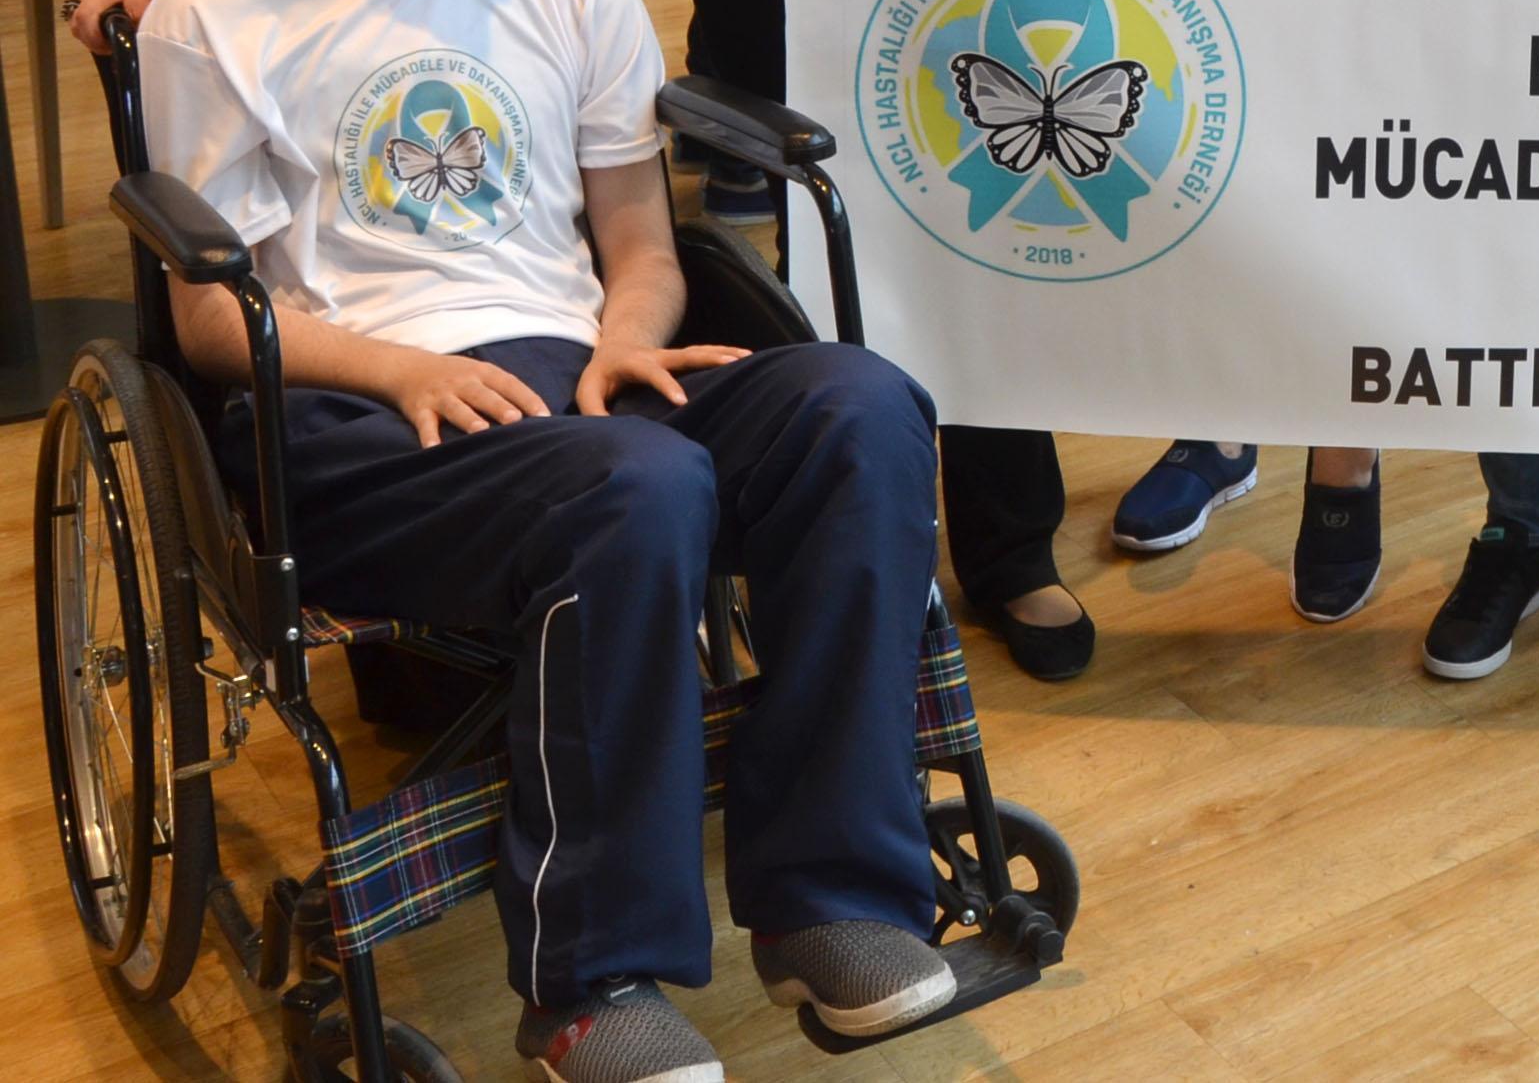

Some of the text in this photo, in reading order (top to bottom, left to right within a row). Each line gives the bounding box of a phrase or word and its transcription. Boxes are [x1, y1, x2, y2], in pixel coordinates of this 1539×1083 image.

[875, 0, 919, 130] HASTALIĞI
[357, 197, 381, 226] NCL
[369, 58, 444, 99] MÜCADELE
[449, 59, 466, 74] VE
[468, 67, 523, 137] DAYANIŞMA
[886, 134, 923, 184] NCL
[1177, 92, 1227, 204] DERNEĞİ
[1025, 245, 1073, 265] 2018
